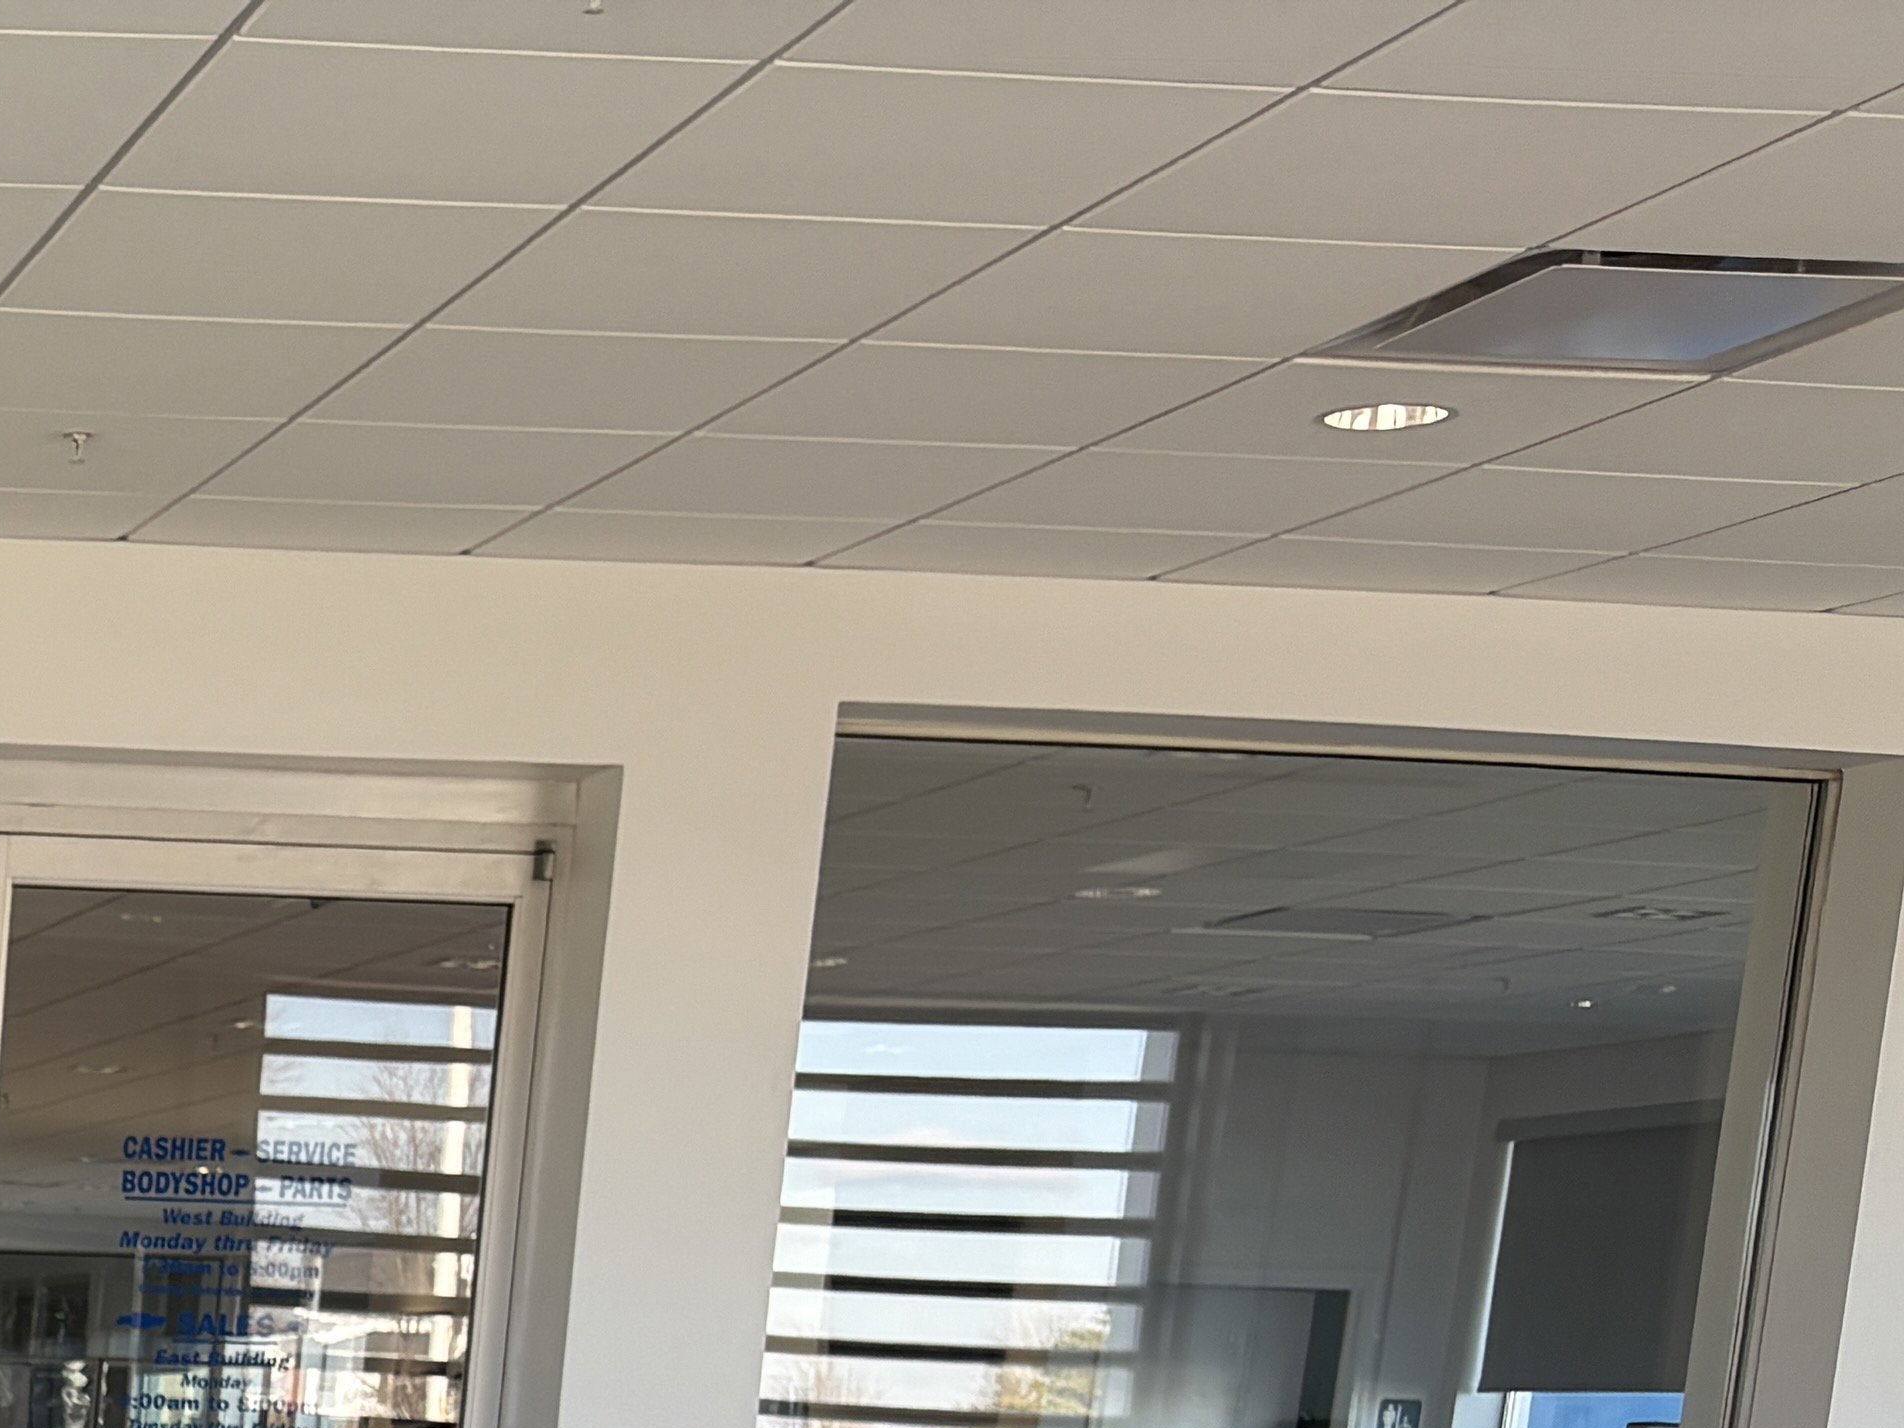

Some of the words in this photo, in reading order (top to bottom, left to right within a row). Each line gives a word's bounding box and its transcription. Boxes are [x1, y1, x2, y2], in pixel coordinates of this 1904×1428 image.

[123, 1136, 226, 1161] CASHIER
[257, 1140, 357, 1166] SERVICE
[122, 1170, 250, 1196] BODYSHOP
[279, 1176, 353, 1200] PARTS
[163, 1208, 212, 1225] West
[219, 1210, 305, 1232] Building
[119, 1232, 206, 1254] Monday
[214, 1234, 255, 1251] thru
[266, 1236, 335, 1257] Friday
[177, 1313, 274, 1338] SALES
[155, 1349, 199, 1366] East
[208, 1349, 293, 1371] Building
[180, 1372, 252, 1390] Monday
[208, 1393, 229, 1411] to
